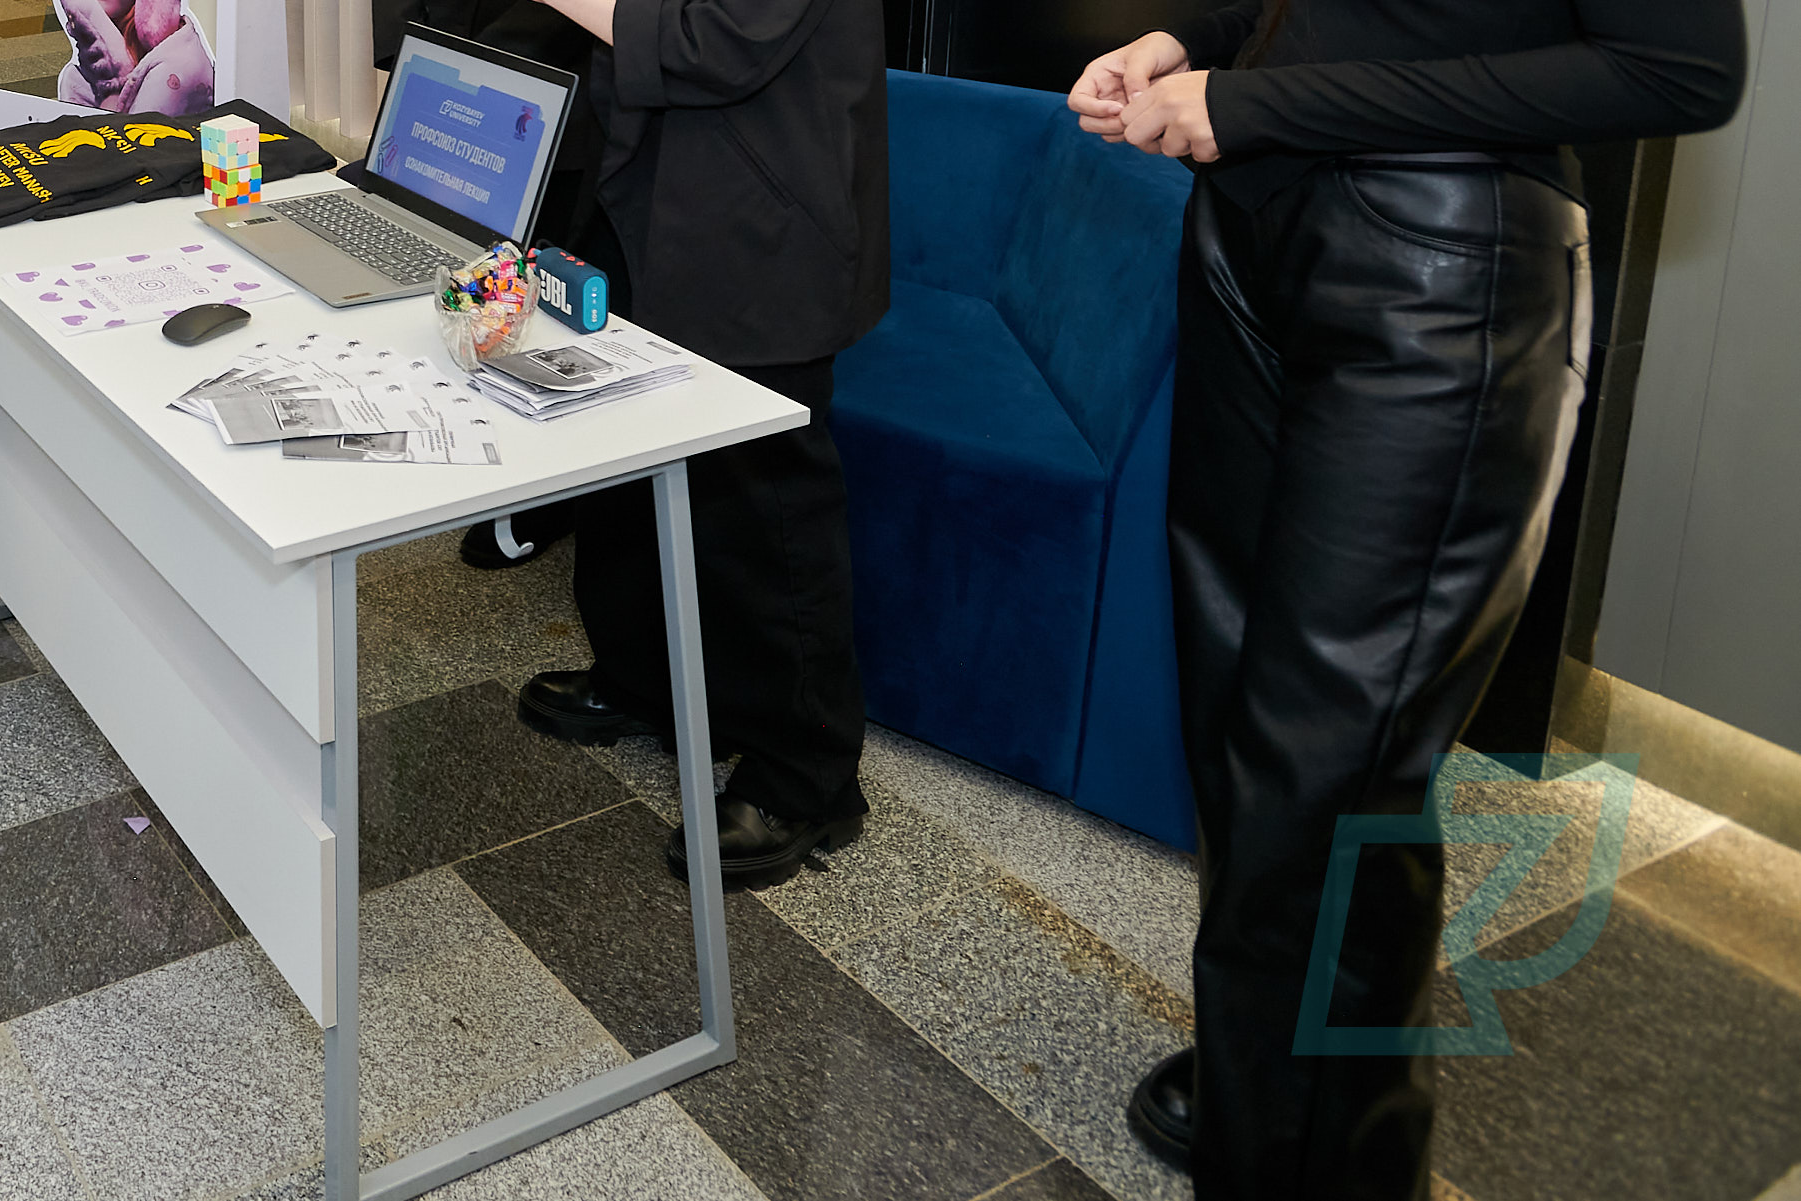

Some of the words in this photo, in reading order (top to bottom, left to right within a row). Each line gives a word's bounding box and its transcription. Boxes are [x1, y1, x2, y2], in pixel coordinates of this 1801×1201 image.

[411, 121, 457, 153] ПРОФСОЮЗ
[455, 140, 506, 174] СТУДЕНТОВ
[540, 269, 572, 316] JBL
